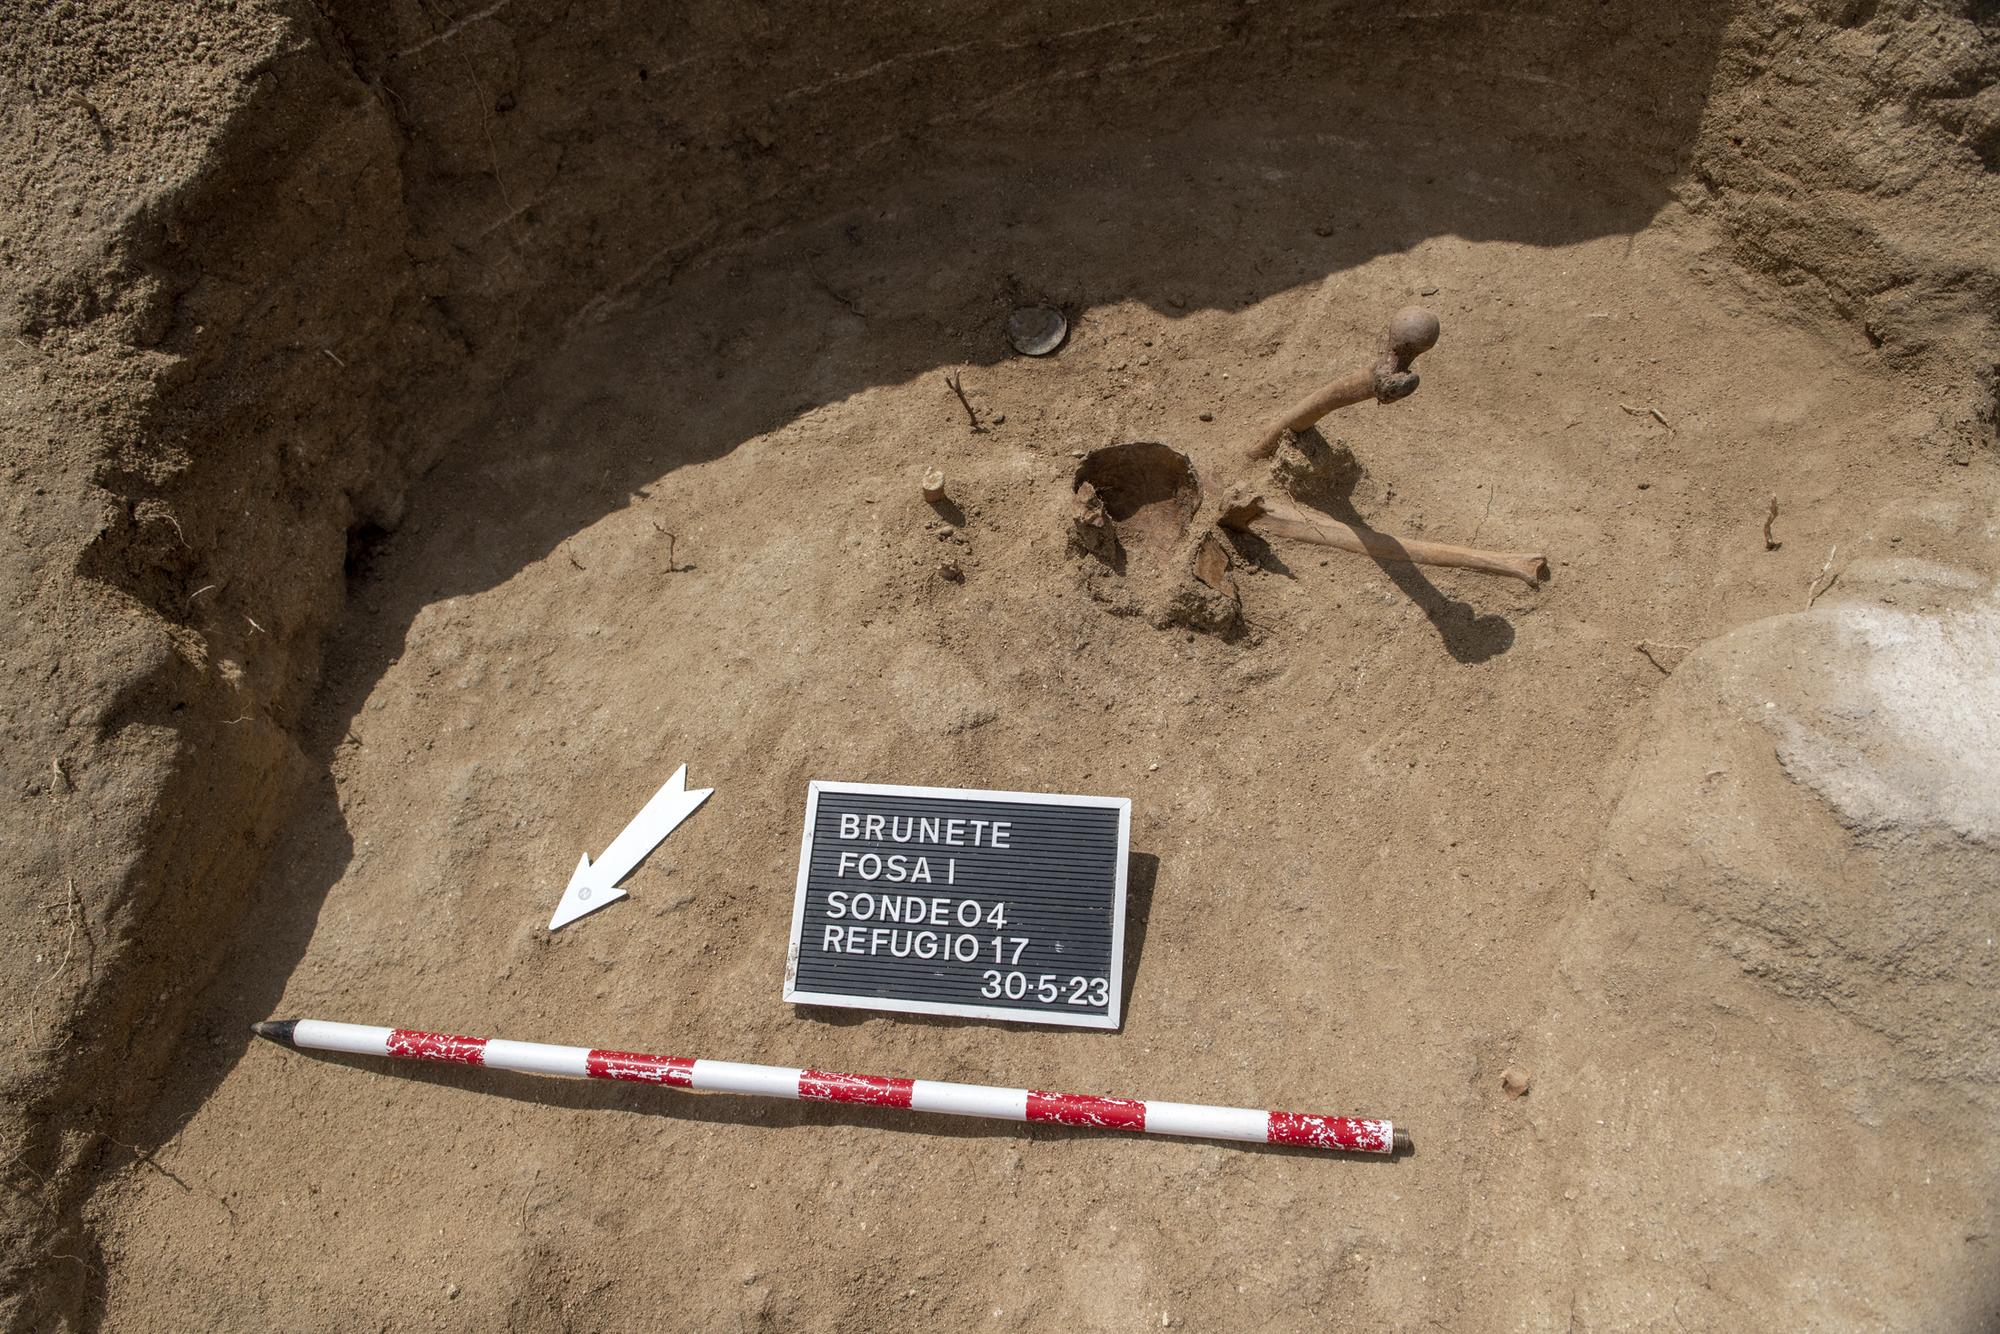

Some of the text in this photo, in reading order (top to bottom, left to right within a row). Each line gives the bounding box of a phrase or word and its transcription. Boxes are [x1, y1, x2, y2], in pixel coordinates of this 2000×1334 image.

[838, 813, 1013, 849] BRUNETE
[836, 851, 932, 884] FOSA
[821, 924, 1030, 966] REFUGIO 17
